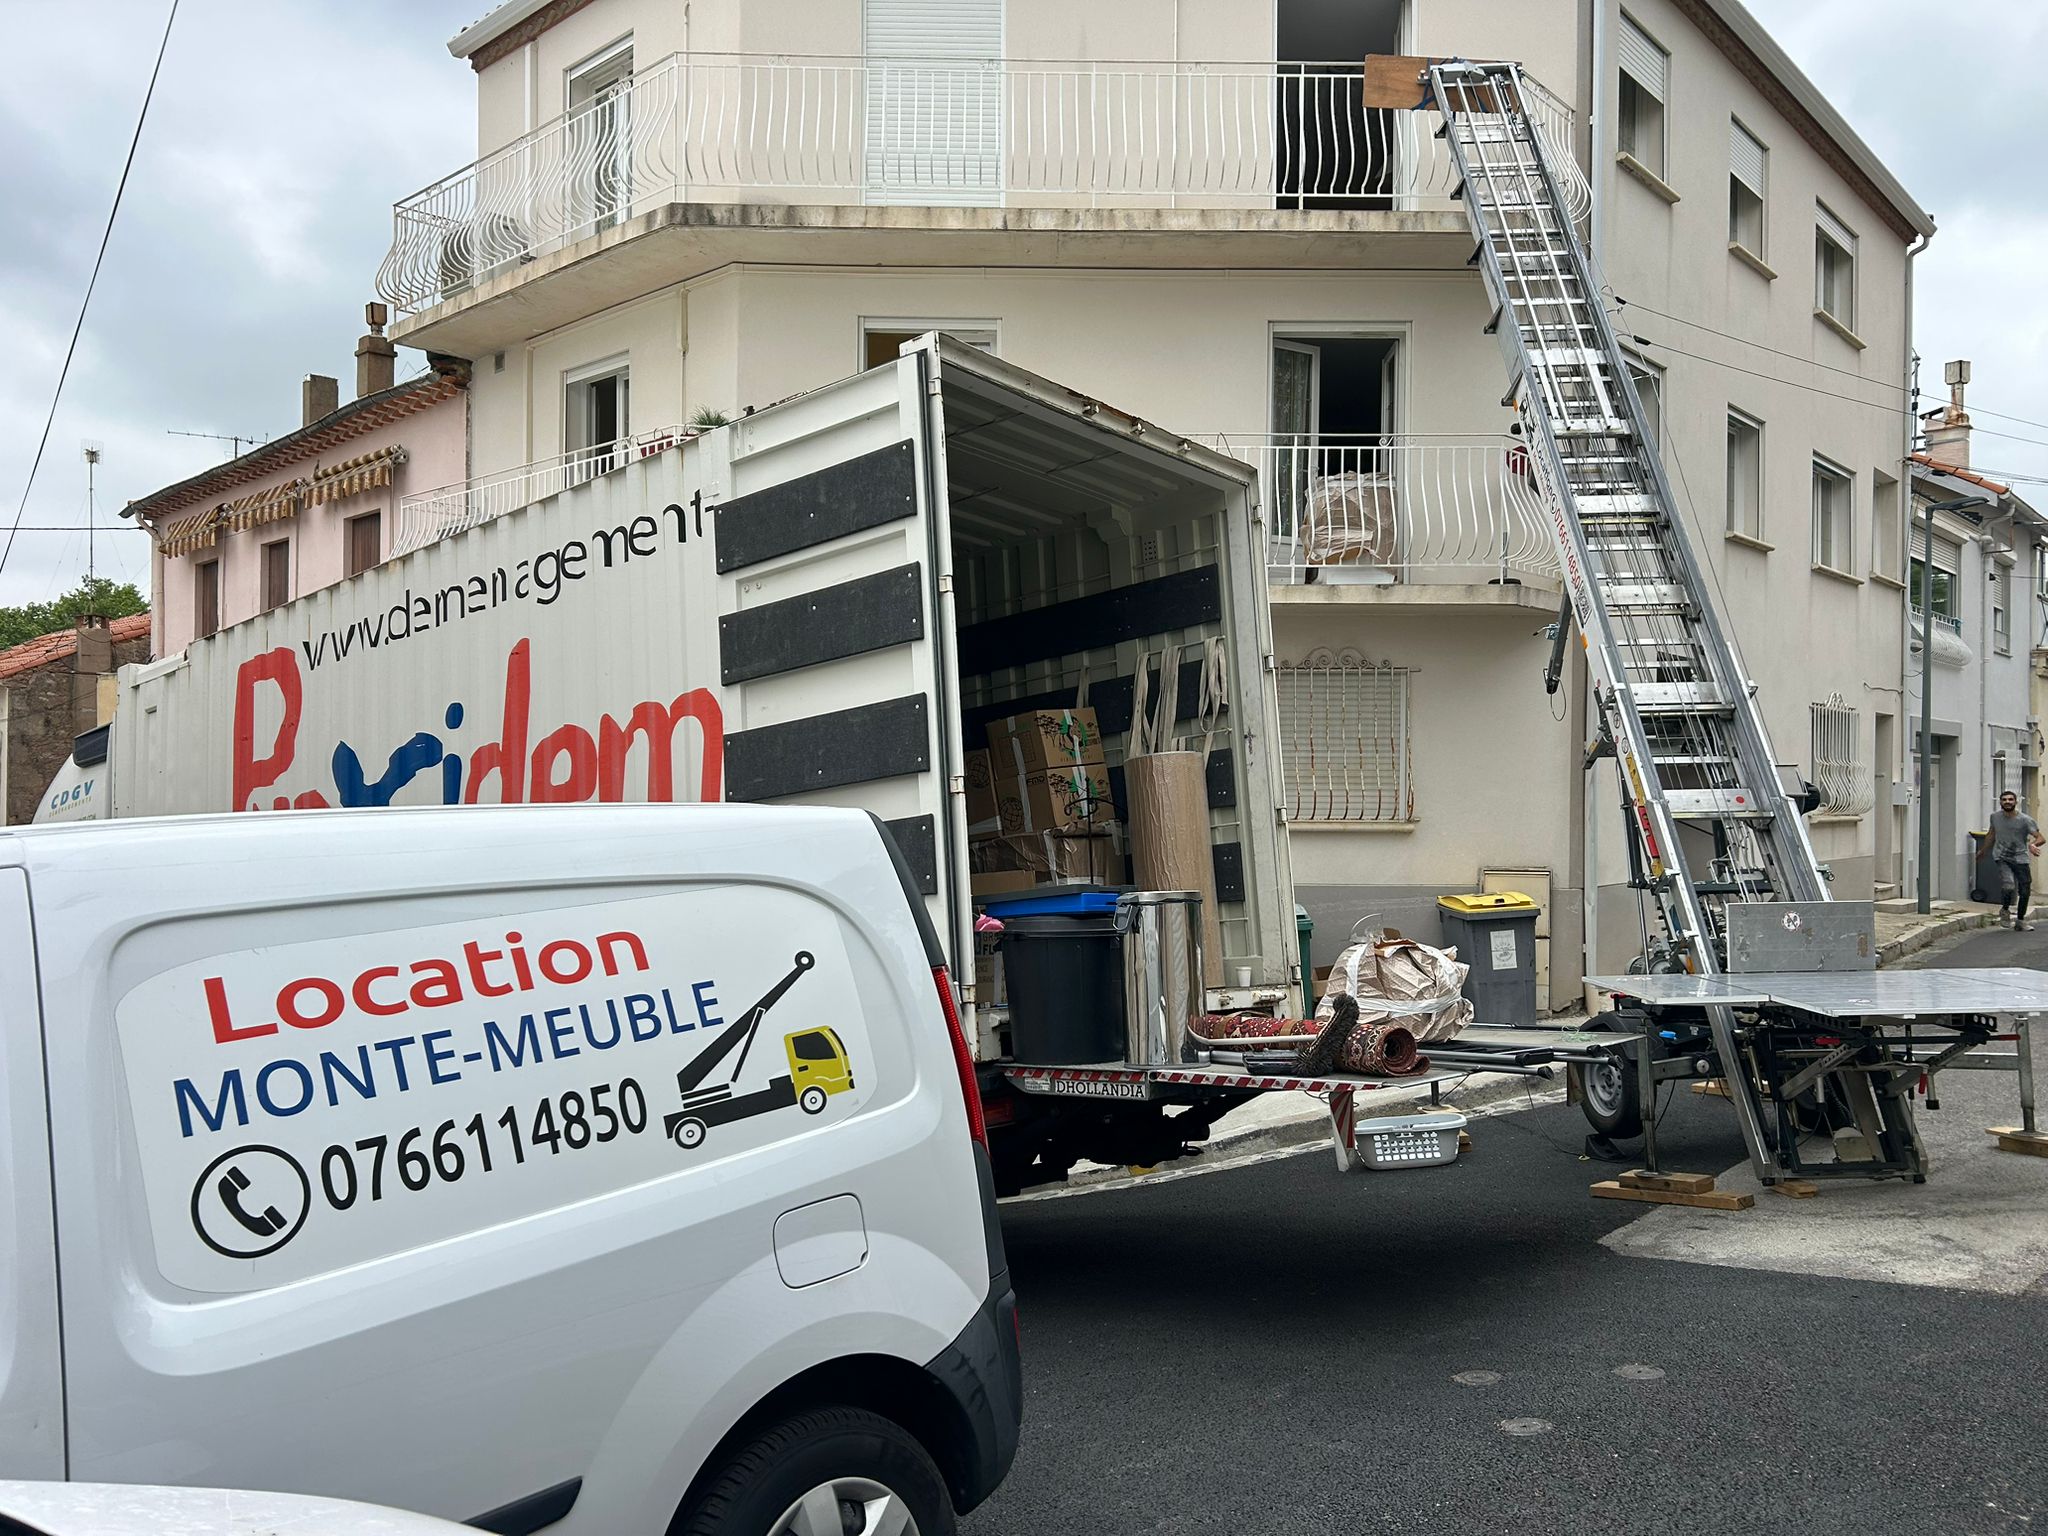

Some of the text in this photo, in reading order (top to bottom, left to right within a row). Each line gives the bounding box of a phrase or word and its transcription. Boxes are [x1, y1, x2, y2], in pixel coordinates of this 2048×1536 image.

[51, 779, 94, 809] CDGV
[203, 931, 650, 1044] Location
[173, 980, 725, 1138] MONTE-MEUBLE
[1057, 1080, 1144, 1098] DHOLLANDIA
[322, 1077, 648, 1211] 0766114850
